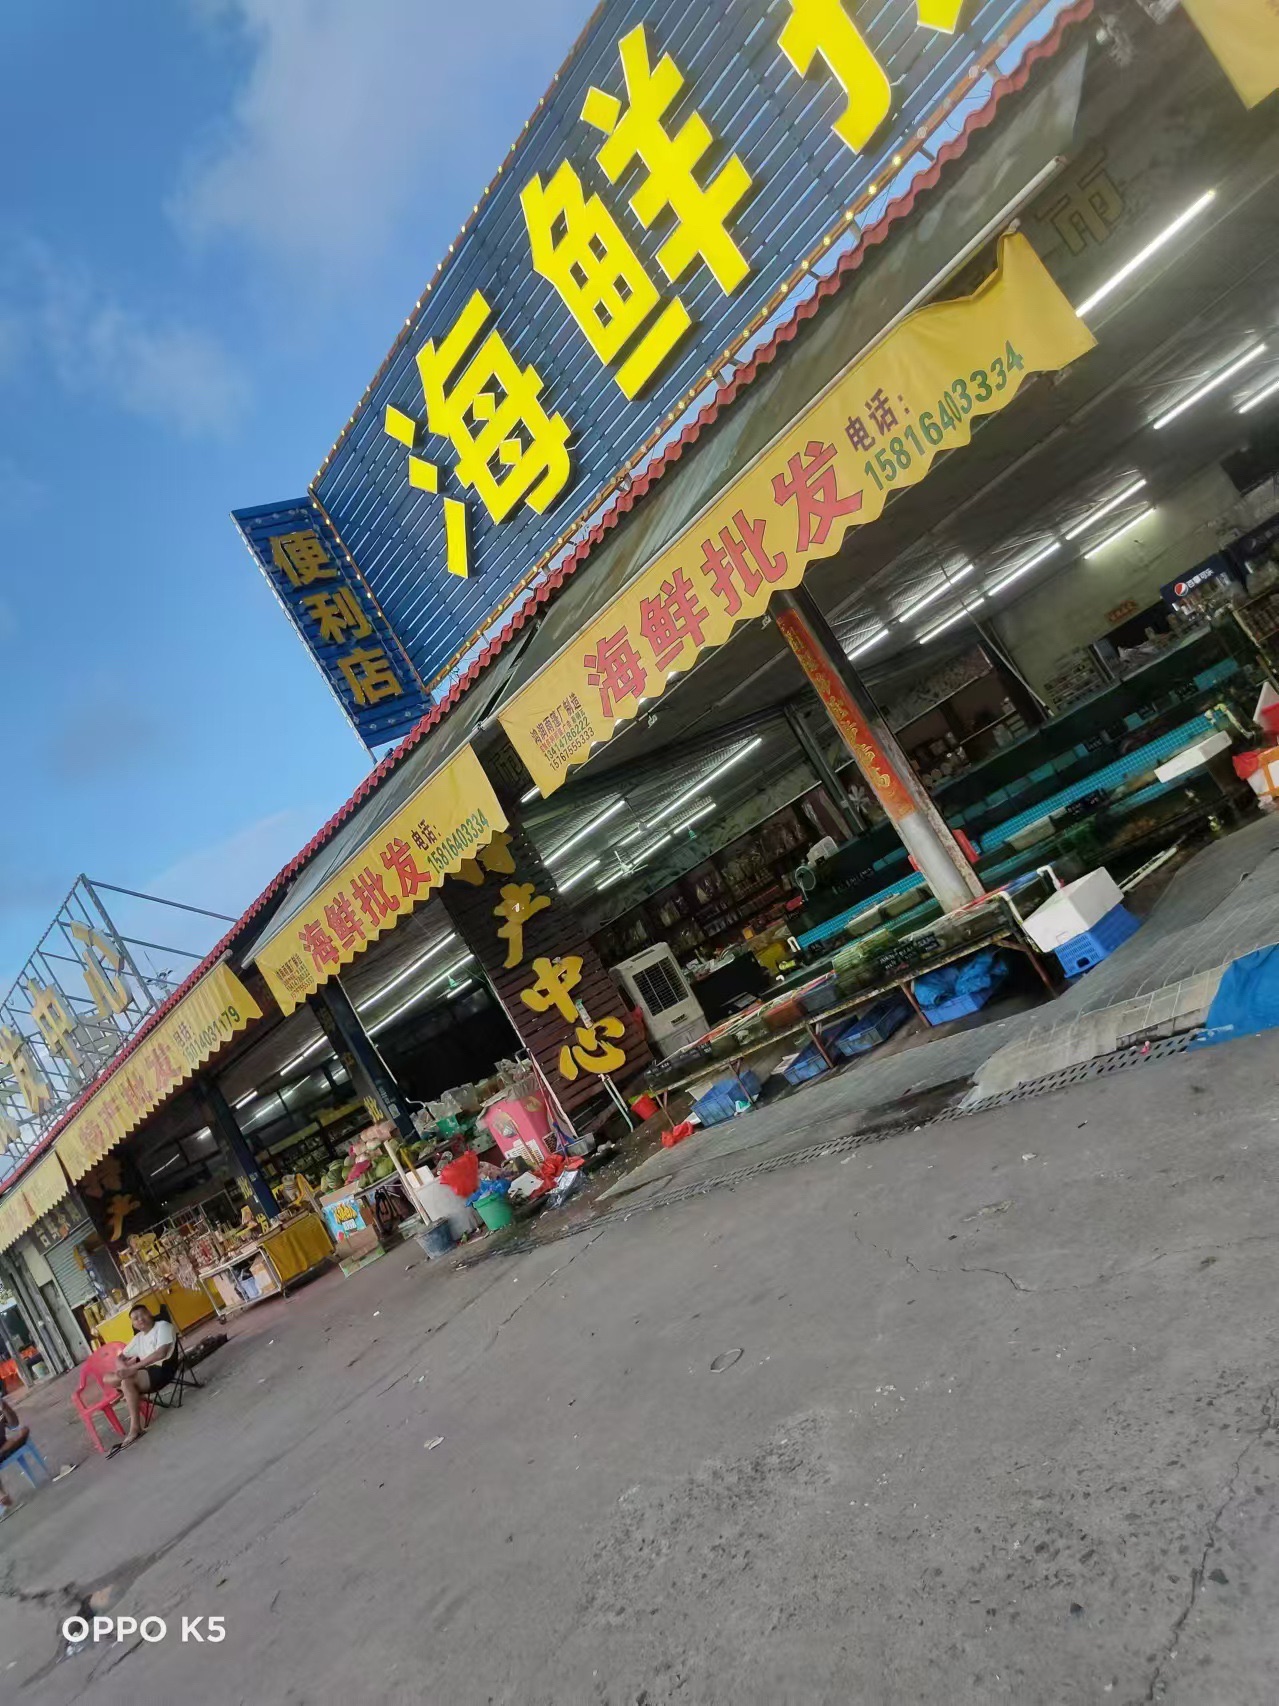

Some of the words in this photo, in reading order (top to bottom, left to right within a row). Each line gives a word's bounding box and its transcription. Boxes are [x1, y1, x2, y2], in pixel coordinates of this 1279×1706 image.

[385, 0, 963, 579] 海鲜
[845, 388, 910, 453] 电话：
[864, 339, 1025, 492] 15816403334
[268, 528, 403, 707] 便利店
[583, 440, 863, 718] 海鲜批发
[544, 716, 591, 762] 13414786222
[549, 726, 595, 771] 15767555333
[298, 837, 431, 974] 海鲜批发
[426, 807, 490, 875] 15816403334
